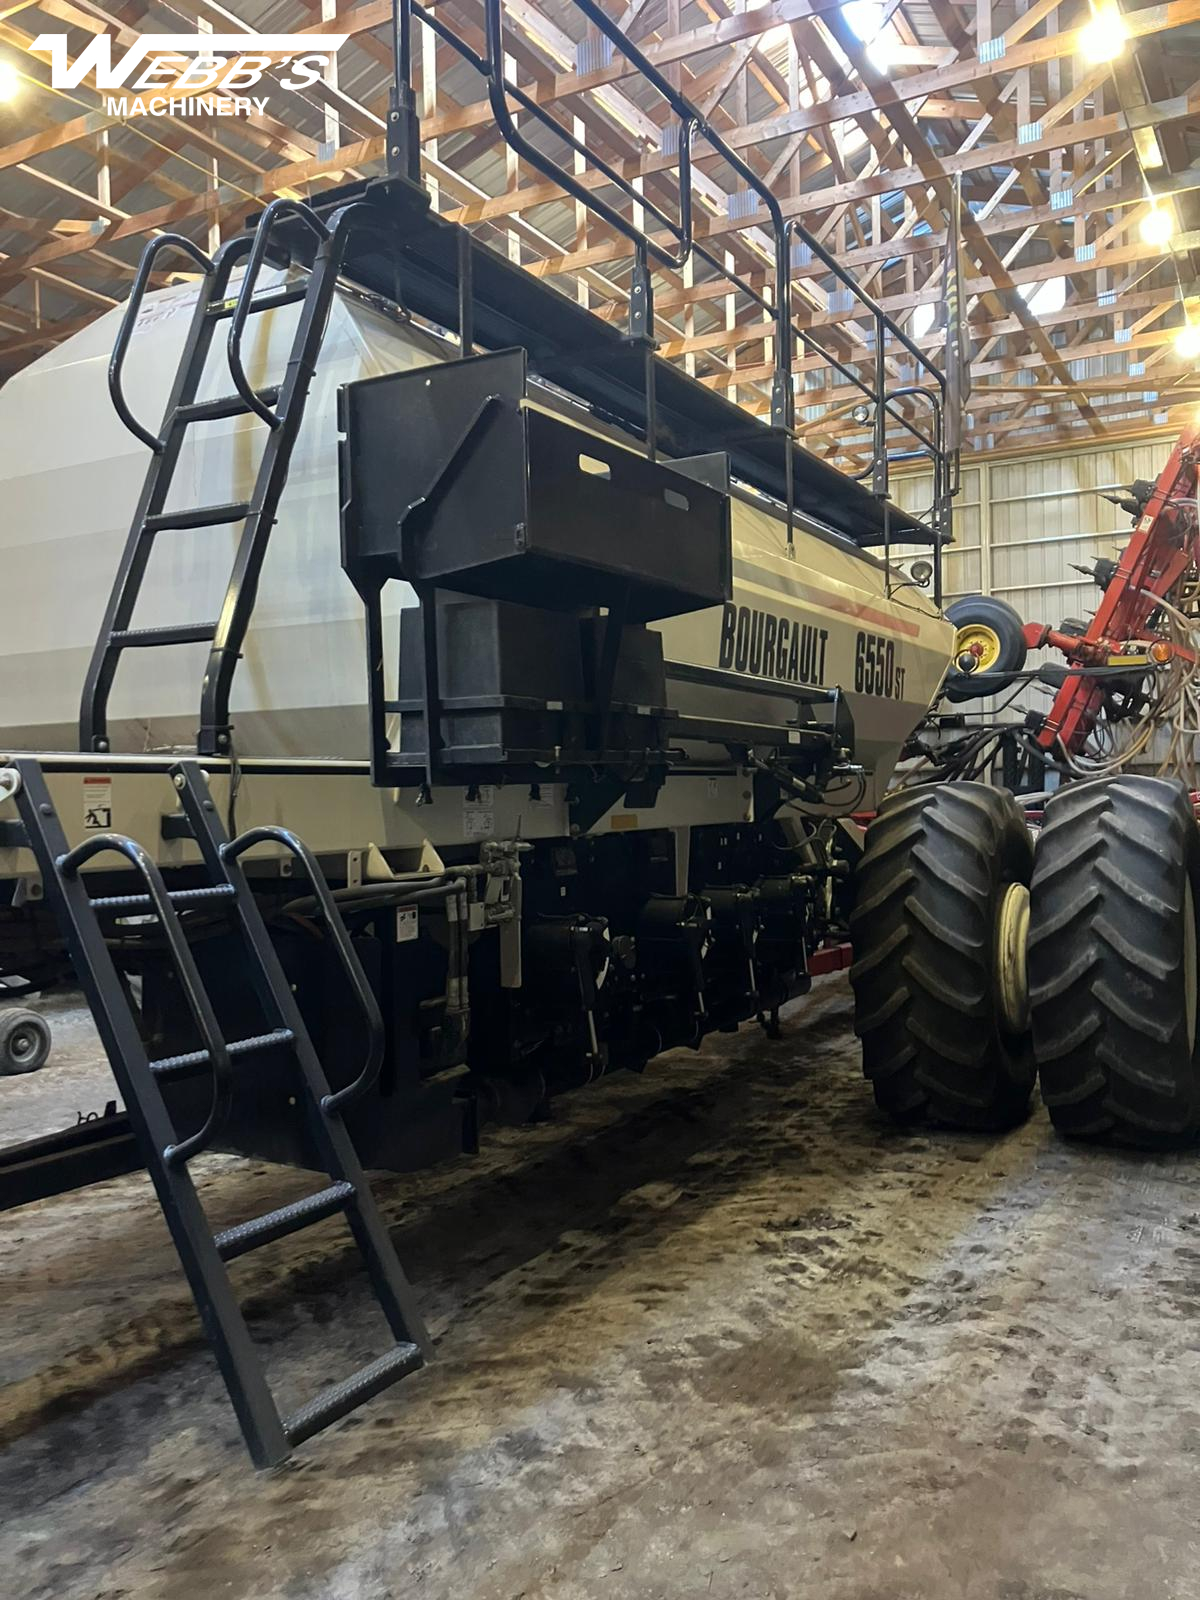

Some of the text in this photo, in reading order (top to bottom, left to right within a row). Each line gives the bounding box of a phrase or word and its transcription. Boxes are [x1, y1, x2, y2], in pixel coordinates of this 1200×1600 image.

[719, 602, 906, 700] BOURGAULT 6550 ST
